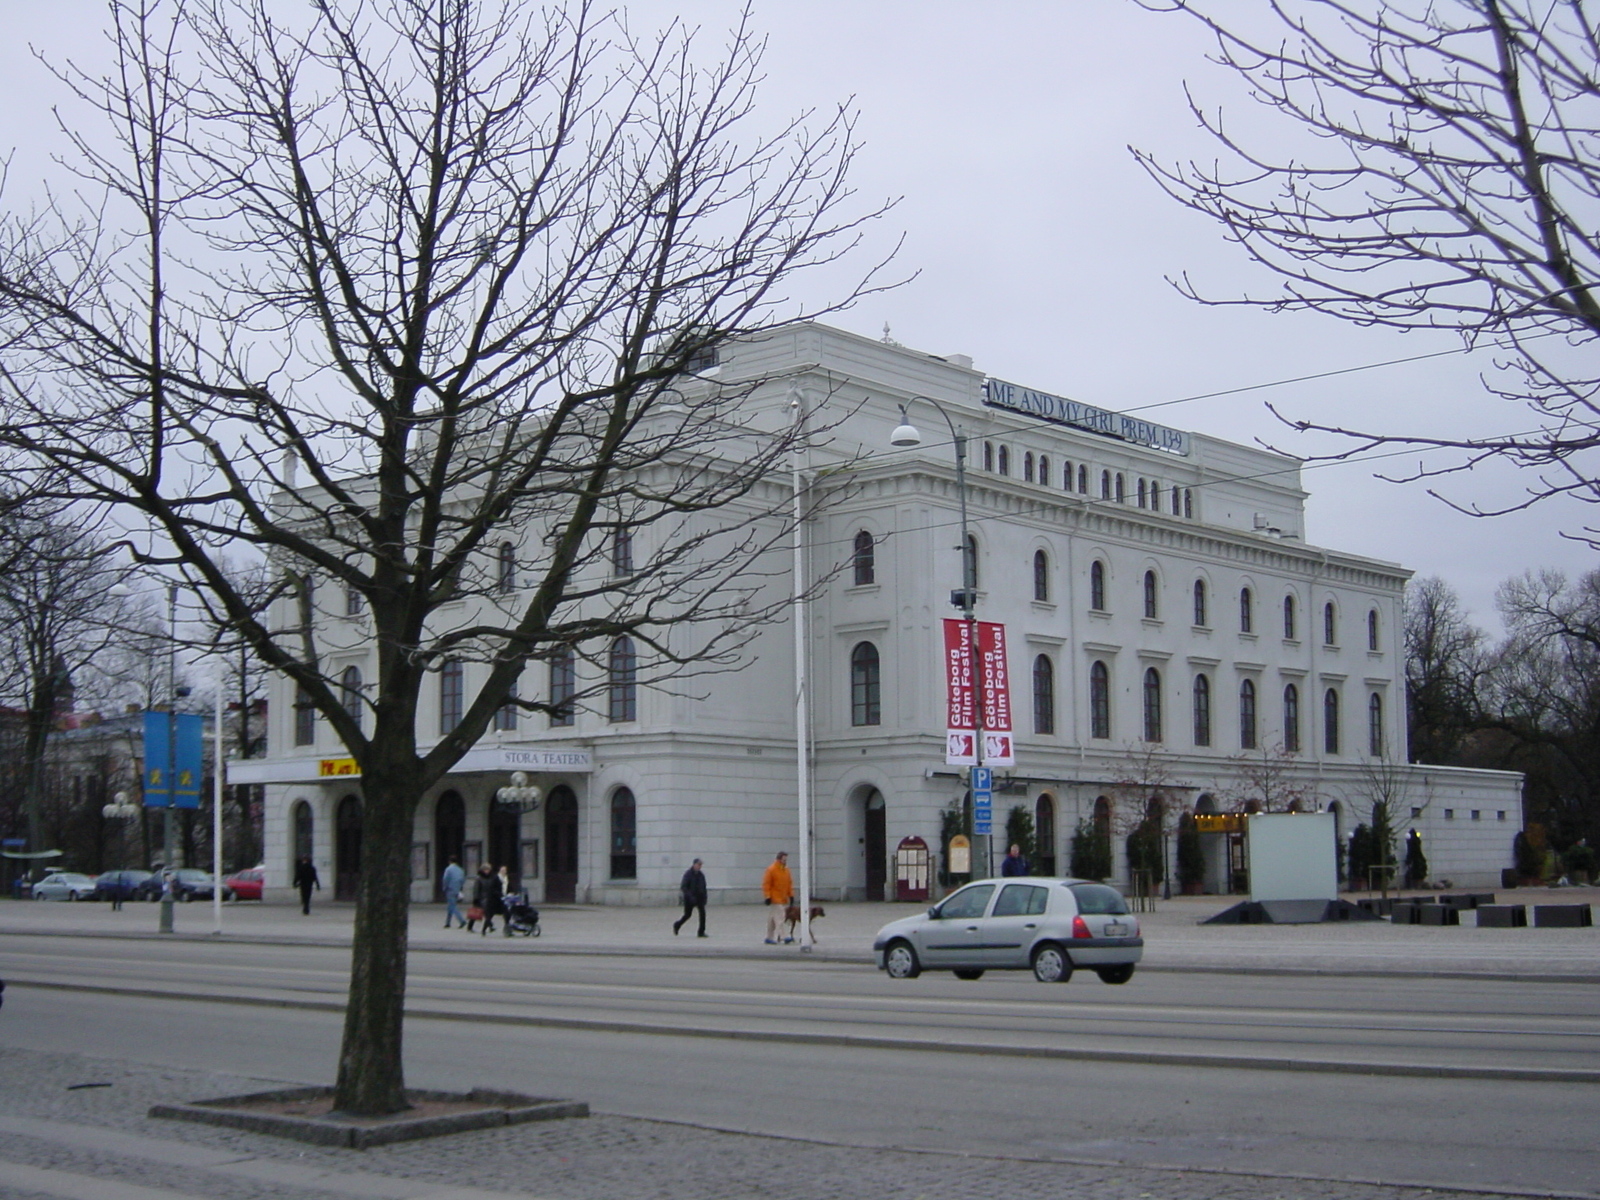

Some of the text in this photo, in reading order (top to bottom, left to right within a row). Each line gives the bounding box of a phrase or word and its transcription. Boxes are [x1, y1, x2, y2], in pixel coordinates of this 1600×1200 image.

[992, 381, 1016, 405] ME
[1020, 390, 1055, 415] AND
[1058, 399, 1081, 422] MY
[1085, 407, 1117, 433] GIRL
[950, 649, 960, 726] Göteborg
[958, 623, 972, 727] Film Festival
[984, 651, 995, 728] Göteborg
[992, 626, 1008, 729] Film Festival
[505, 752, 589, 765] STORA TEATERN
[977, 770, 987, 788] P
